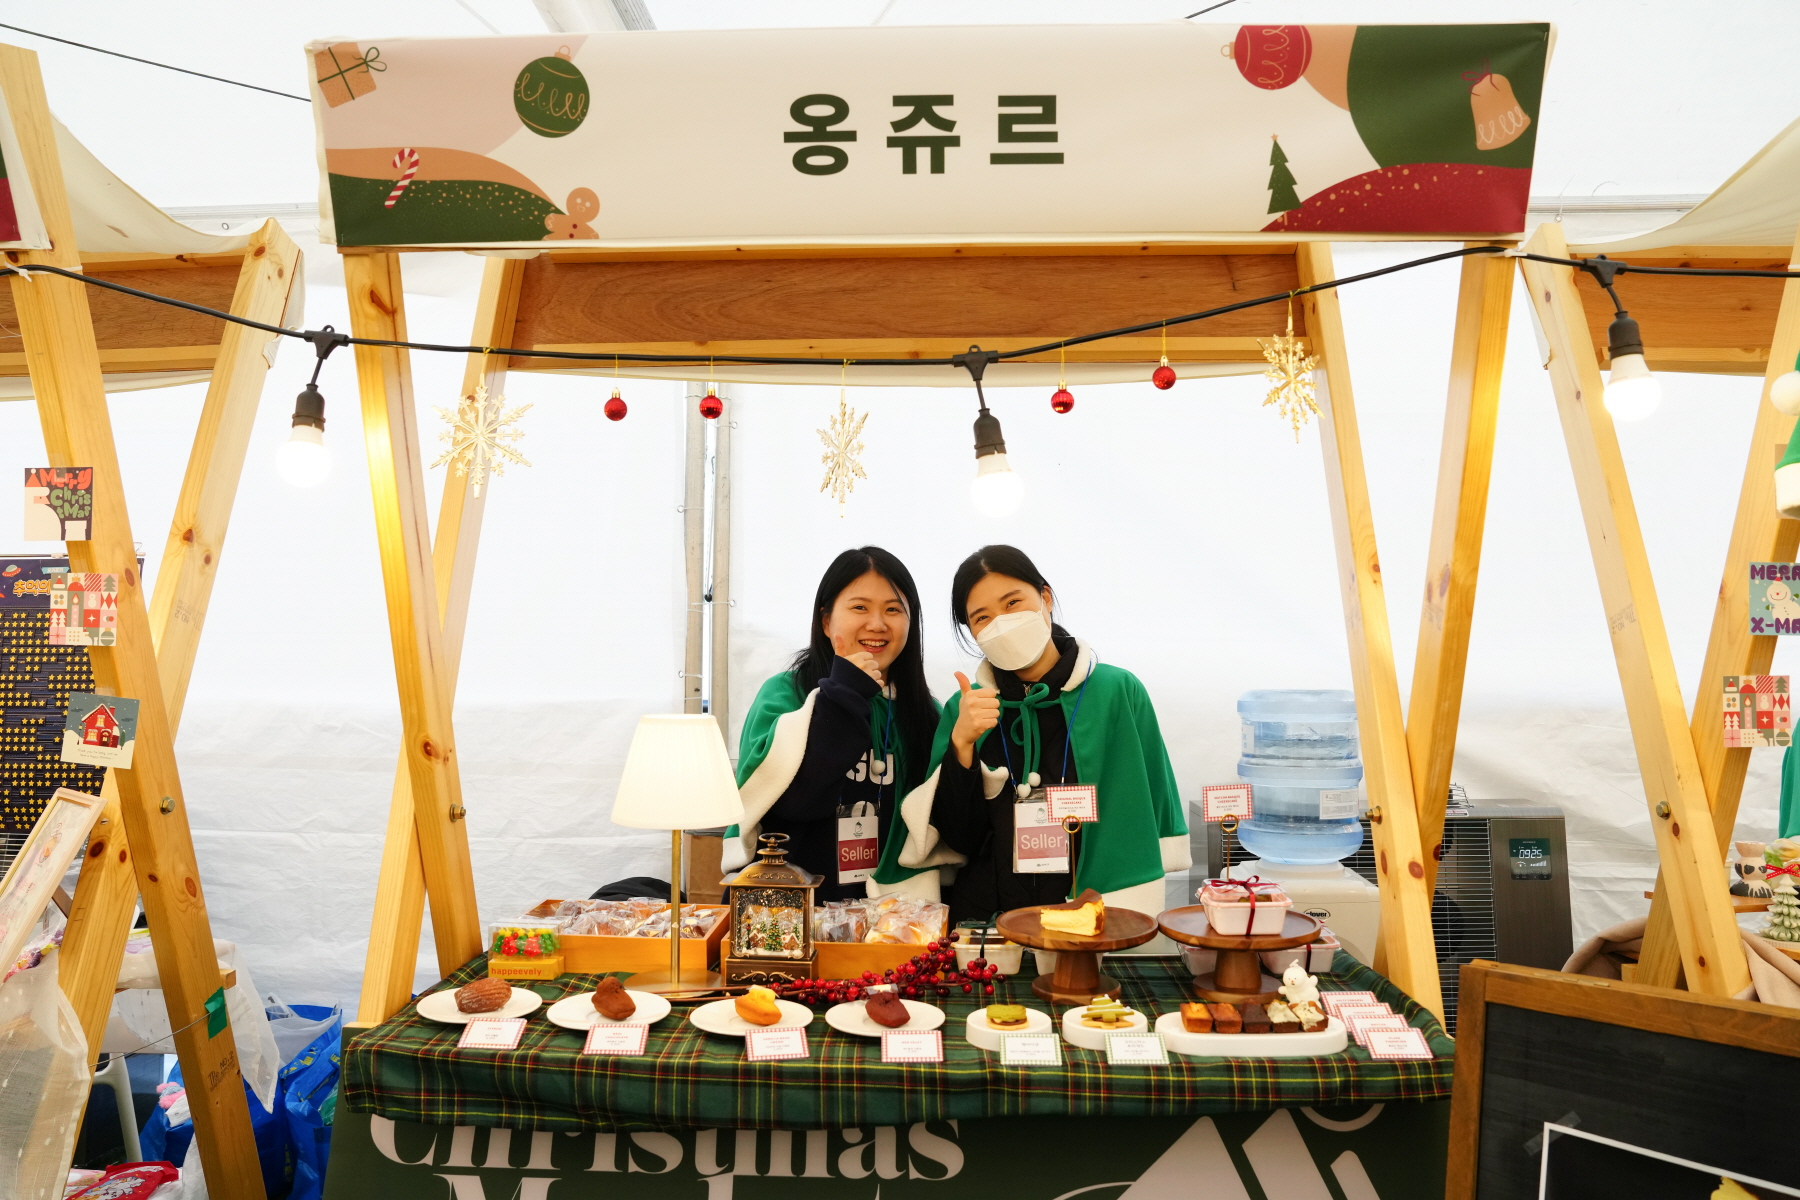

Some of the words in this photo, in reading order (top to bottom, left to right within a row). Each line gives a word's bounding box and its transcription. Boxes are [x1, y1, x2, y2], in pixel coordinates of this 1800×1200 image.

[784, 93, 1064, 176] 옹쥬르
[39, 468, 92, 490] Merry
[50, 486, 91, 506] Chris
[1021, 833, 1064, 850] Seller
[841, 846, 876, 862] Seller
[491, 967, 542, 976] happeevely
